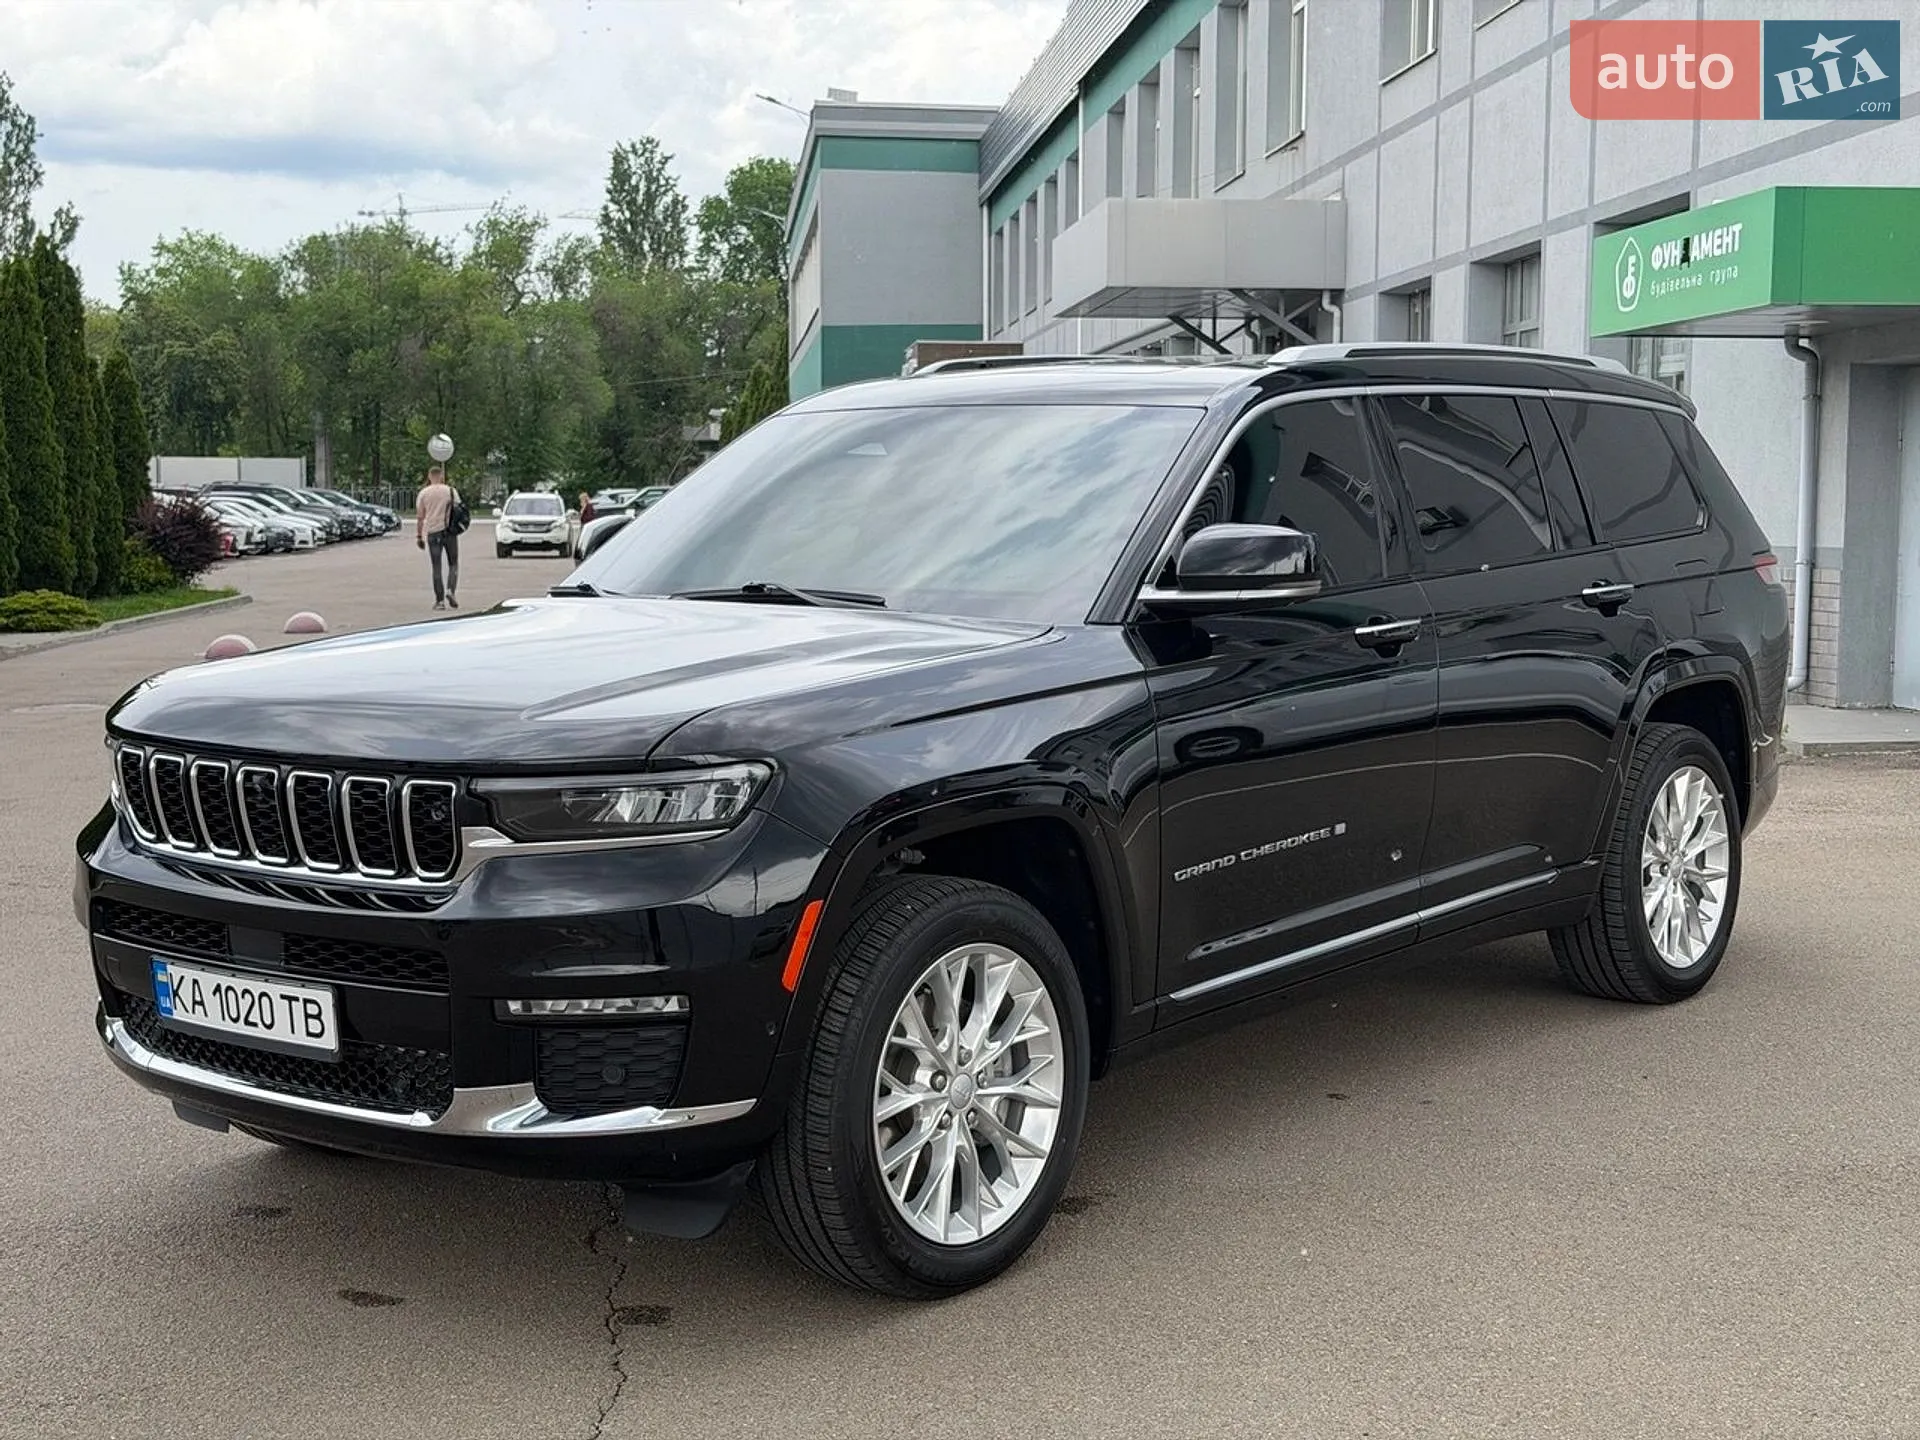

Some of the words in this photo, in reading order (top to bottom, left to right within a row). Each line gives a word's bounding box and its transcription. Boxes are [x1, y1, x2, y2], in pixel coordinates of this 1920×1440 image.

[1650, 274, 1703, 299] будівельна
[1710, 265, 1739, 285] група
[1174, 854, 1236, 881] GRAND
[1240, 827, 1332, 861] CHEROKEE
[160, 995, 171, 1008] UA
[169, 972, 208, 1017] KA
[212, 982, 275, 1030] 1020
[280, 993, 325, 1039] TB
